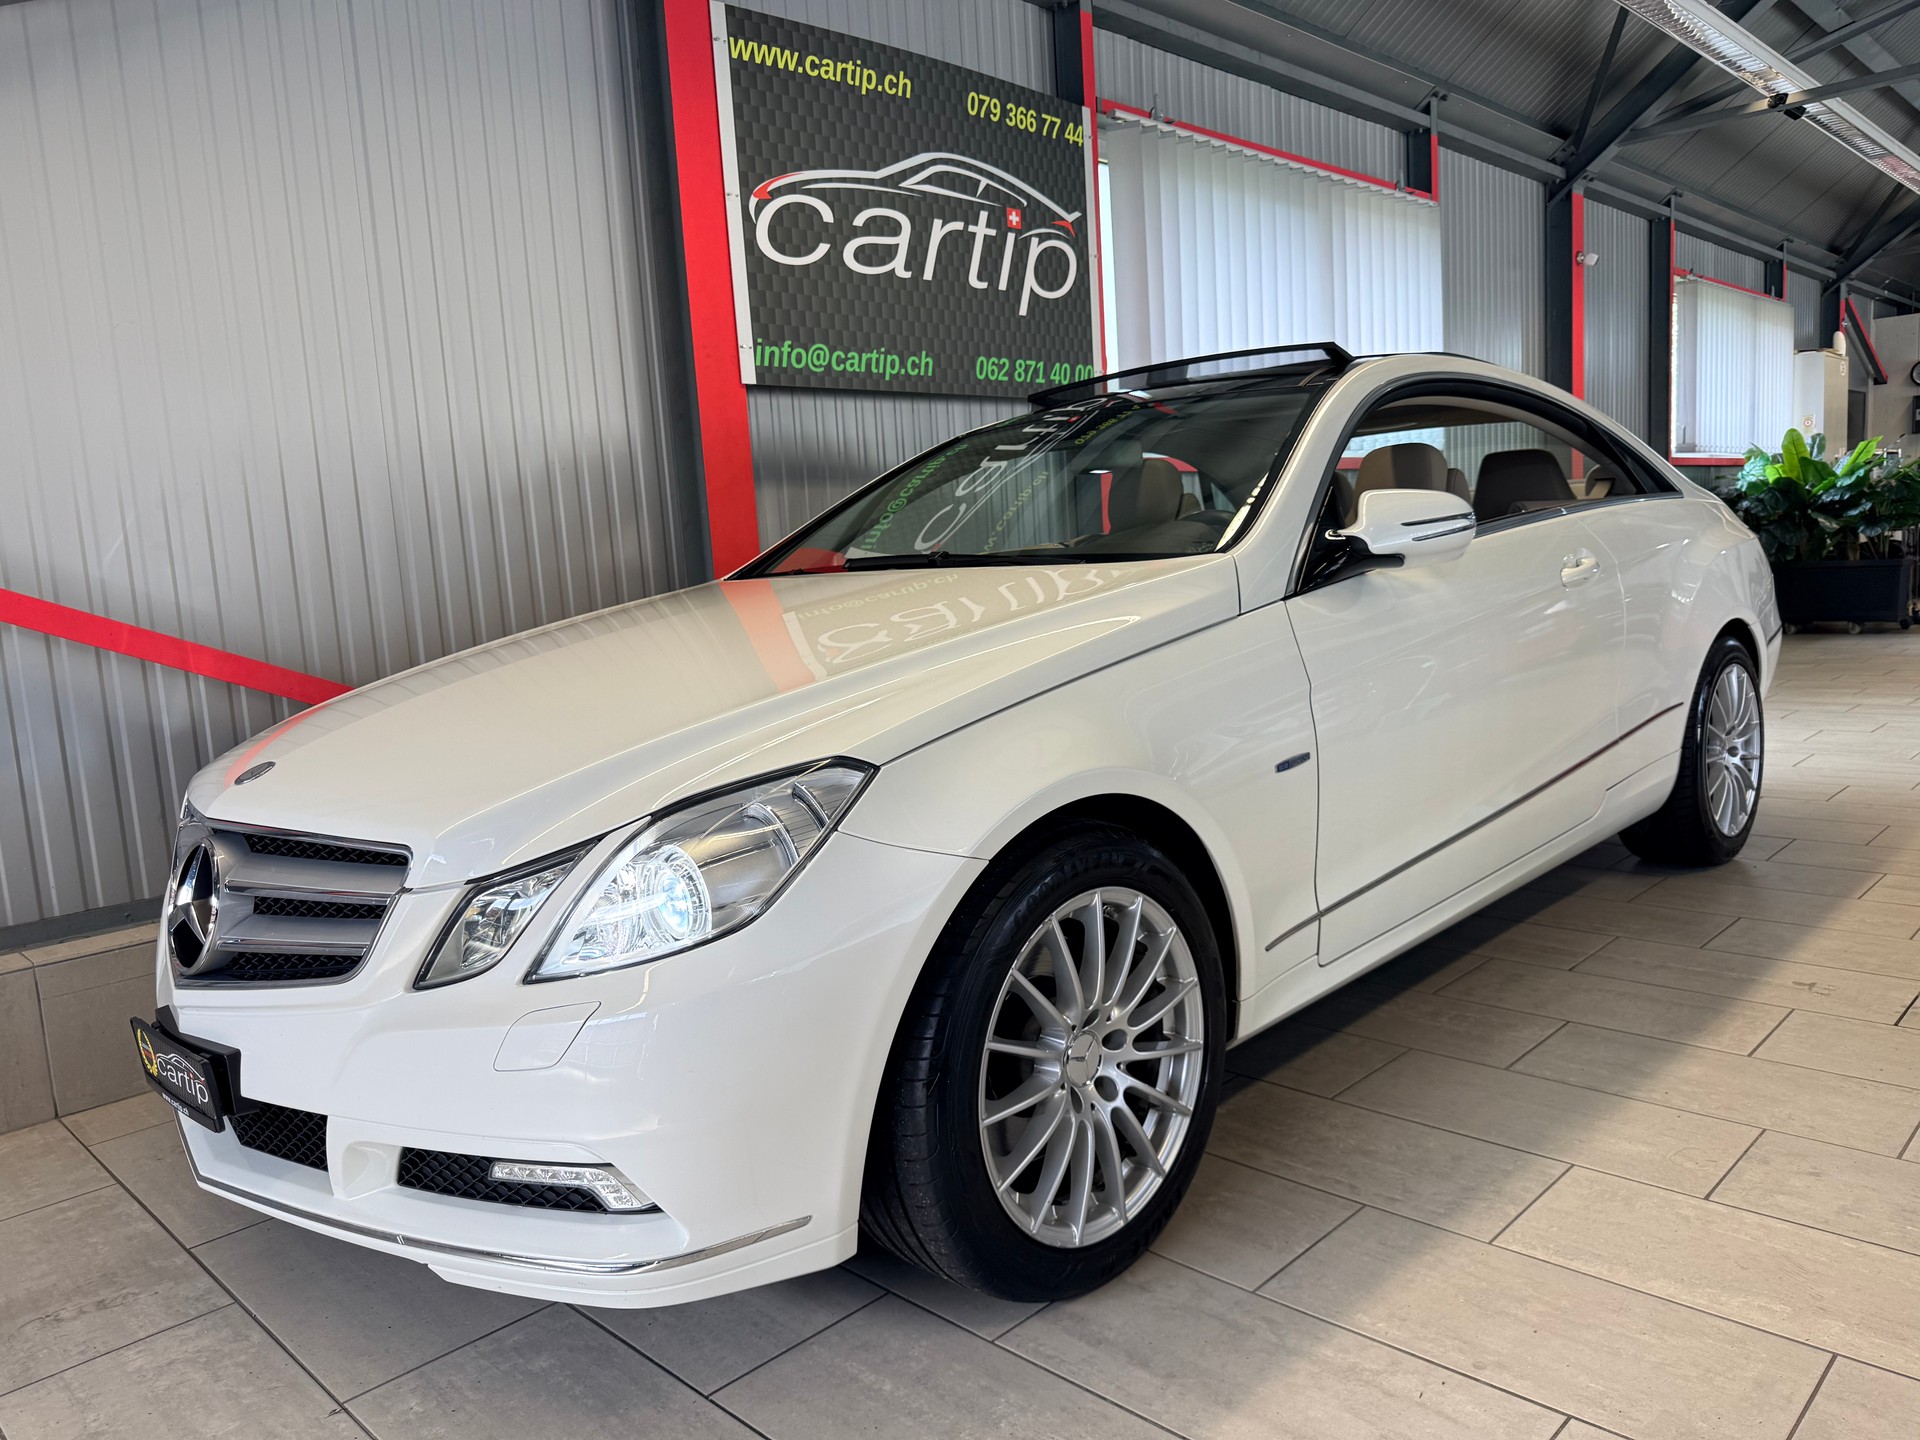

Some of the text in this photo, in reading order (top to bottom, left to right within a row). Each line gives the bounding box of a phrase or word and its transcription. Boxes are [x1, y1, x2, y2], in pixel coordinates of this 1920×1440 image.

[729, 36, 913, 99] www.cartip.ch
[967, 91, 1084, 147] 079 366 77 44
[755, 194, 1077, 317] cartip
[755, 338, 933, 381] info@cartip.ch
[975, 356, 1094, 385] 062 871 40 00
[156, 1057, 209, 1105] cartip
